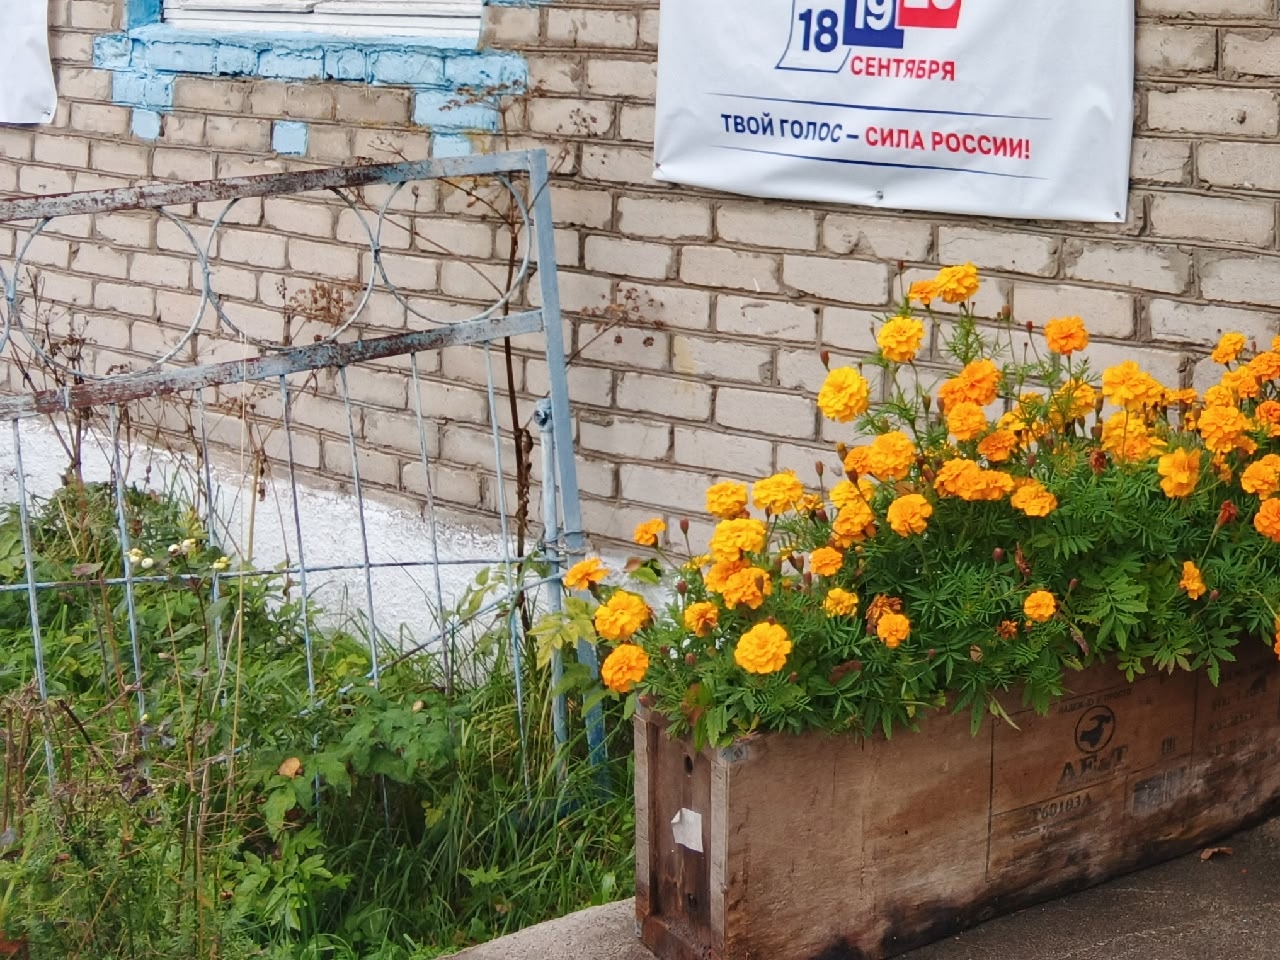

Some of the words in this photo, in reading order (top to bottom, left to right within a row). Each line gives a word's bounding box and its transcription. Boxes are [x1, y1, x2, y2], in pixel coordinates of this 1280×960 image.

[798, 7, 839, 53] 18
[850, 55, 956, 82] СЕНТЯБРЯ
[721, 112, 774, 136] ТВОЙ
[779, 119, 843, 143] ГОЛОС
[865, 126, 926, 151] СИЛА
[931, 133, 1031, 160] РОССИИ!
